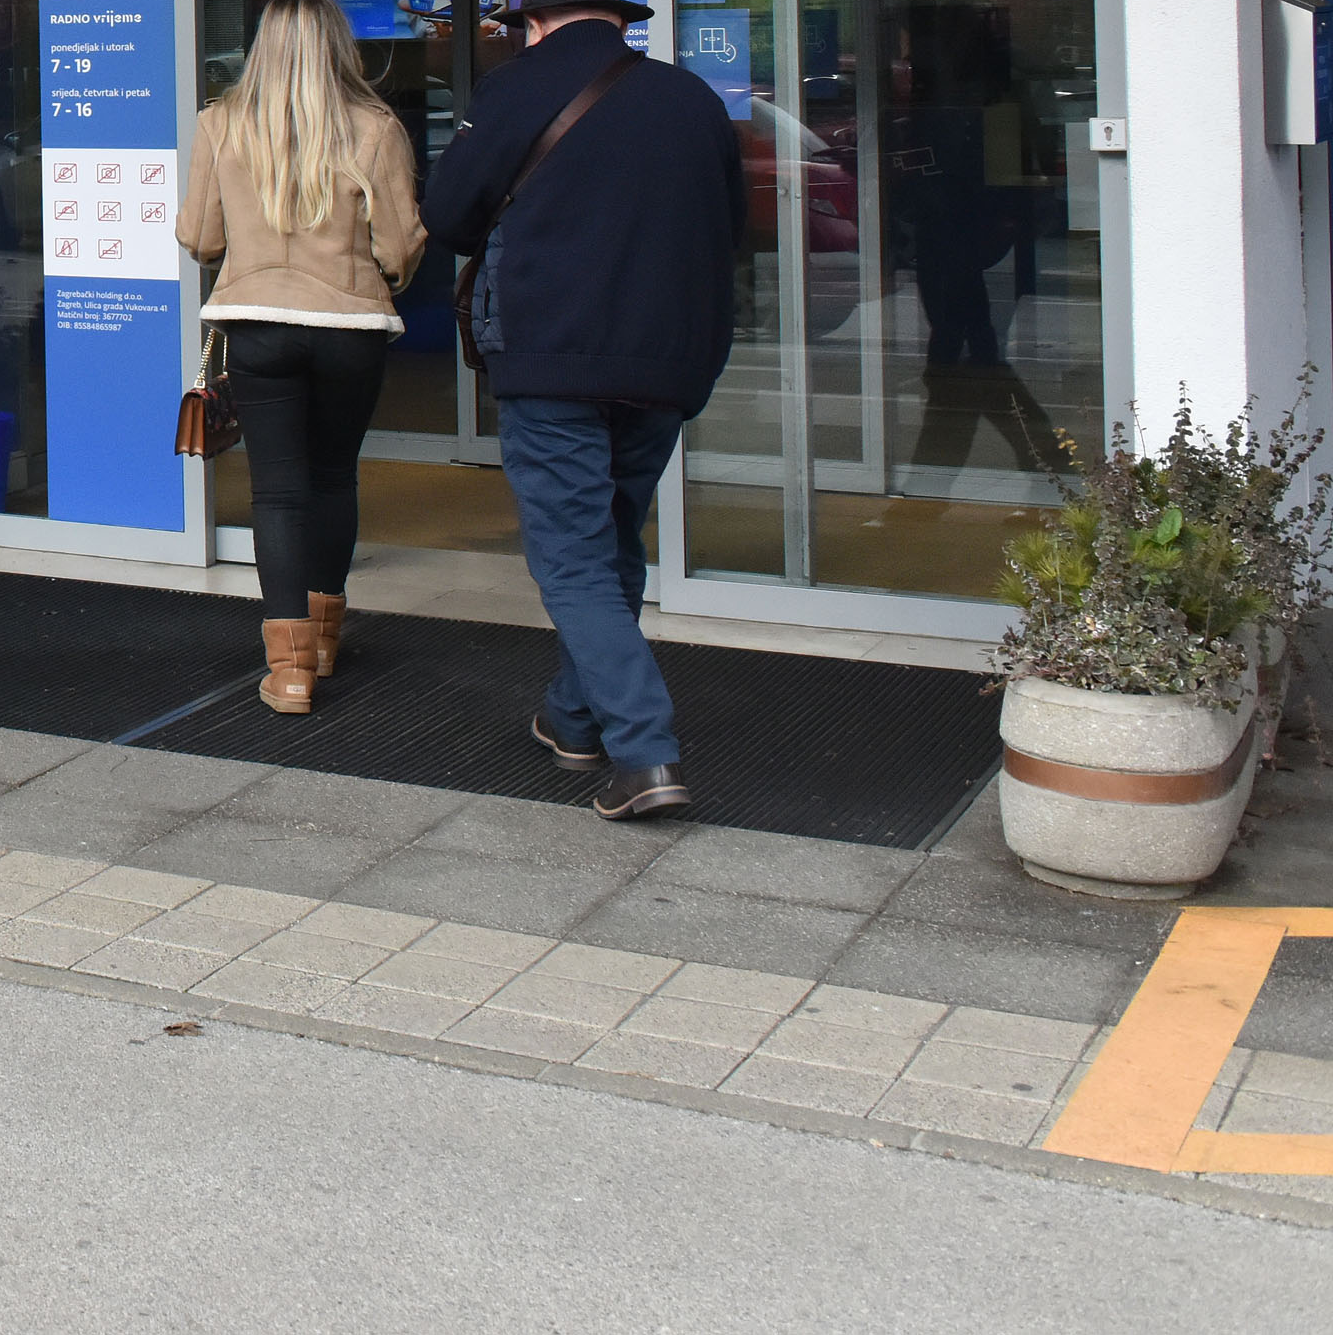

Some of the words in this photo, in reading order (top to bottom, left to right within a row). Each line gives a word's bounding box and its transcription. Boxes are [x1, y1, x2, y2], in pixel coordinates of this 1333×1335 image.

[51, 14, 90, 24] RADNO
[93, 10, 142, 27] vrijeme
[51, 43, 99, 54] ponedjeljak
[101, 43, 104, 51] i
[106, 42, 134, 51] utorak
[51, 59, 60, 73] 7
[75, 59, 91, 73] 19
[51, 89, 82, 98] srijeda,
[83, 88, 119, 97] četvrtak
[121, 88, 124, 96] i
[126, 88, 150, 98] petak
[52, 103, 61, 117] 7
[75, 102, 92, 117] 16
[57, 290, 94, 299] Zagrebački
[96, 291, 122, 301] holding
[57, 300, 82, 310] Zagreb,
[84, 301, 102, 310] Ulica
[103, 303, 123, 312] grada
[125, 304, 158, 312] Vukovara
[57, 311, 83, 319] Matični
[84, 312, 101, 322] broj:
[57, 321, 72, 329] OIB:
